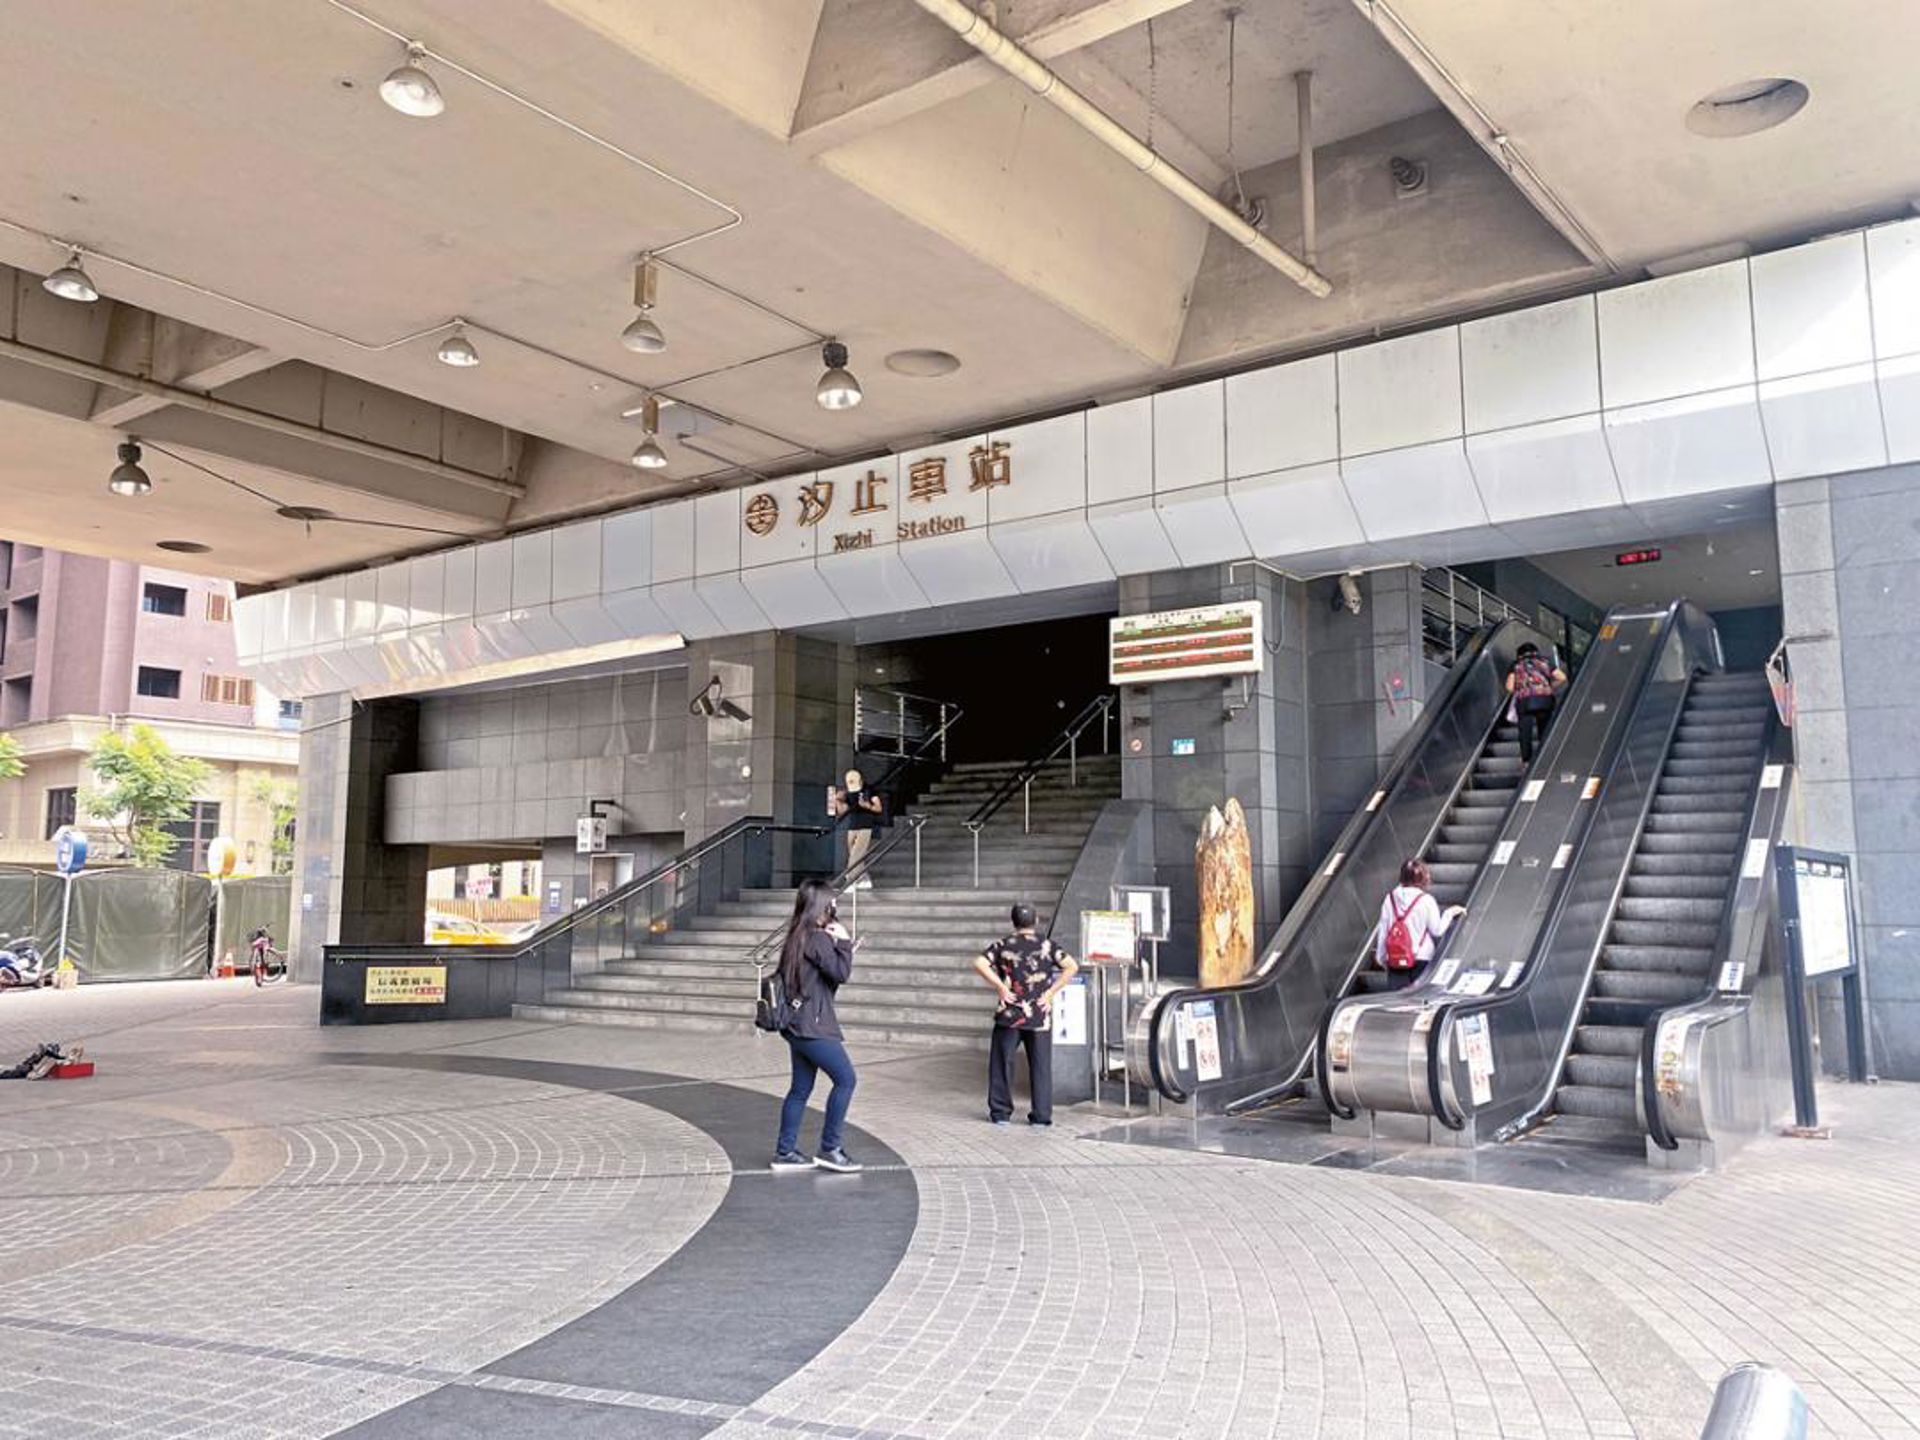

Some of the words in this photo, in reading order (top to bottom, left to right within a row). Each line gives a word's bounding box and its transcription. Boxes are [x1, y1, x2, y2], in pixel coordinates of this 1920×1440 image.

[797, 441, 1011, 527] 汐止車站
[834, 529, 873, 554] Xizhi
[897, 515, 966, 539] Station
